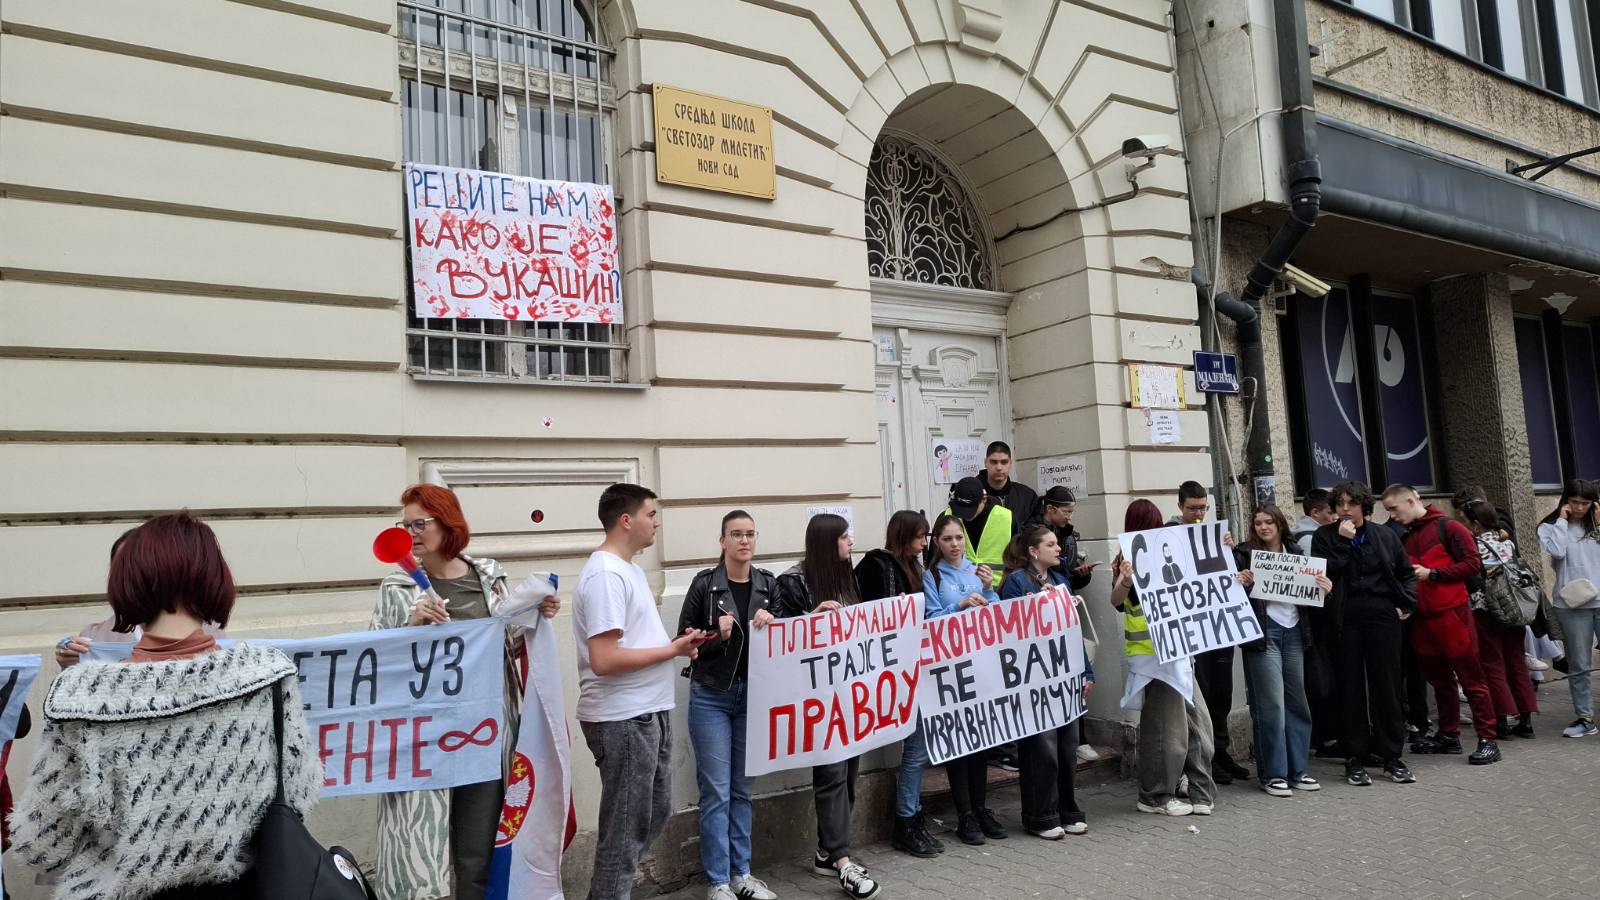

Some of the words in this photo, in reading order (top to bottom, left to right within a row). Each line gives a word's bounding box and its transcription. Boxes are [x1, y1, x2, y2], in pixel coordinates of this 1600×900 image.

[674, 102, 716, 127] СРЕДЊА
[721, 112, 756, 134] ШКОЛА
[409, 169, 518, 215] РЕЦИТЕ
[528, 181, 591, 220] НАМ
[697, 158, 719, 175] НОВИ
[723, 163, 740, 179] САД
[414, 218, 500, 251] КАКО
[521, 223, 567, 256] ЈЕ
[436, 257, 622, 305] ВУКАШИН?
[1187, 522, 1228, 576] Ш
[1254, 551, 1276, 561] НЕМА
[1277, 554, 1300, 564] ПОСЛА
[1303, 557, 1309, 566] У
[1261, 580, 1321, 602] УЛИЦАМА
[1272, 573, 1282, 581] СУ
[767, 595, 916, 658] ПЛЕНУМАШИ
[920, 587, 1079, 666] ЕКОНОМИСТИ
[408, 636, 465, 699] УЗ
[800, 633, 898, 689] ТРАЖЕ
[929, 659, 977, 707] ЋЕ
[999, 635, 1070, 690] ВАМ
[768, 660, 921, 760] ПРАВДУ
[923, 692, 1027, 763] ИЗРАВНАТИ
[1029, 672, 1088, 732] РАЧУНЕ
